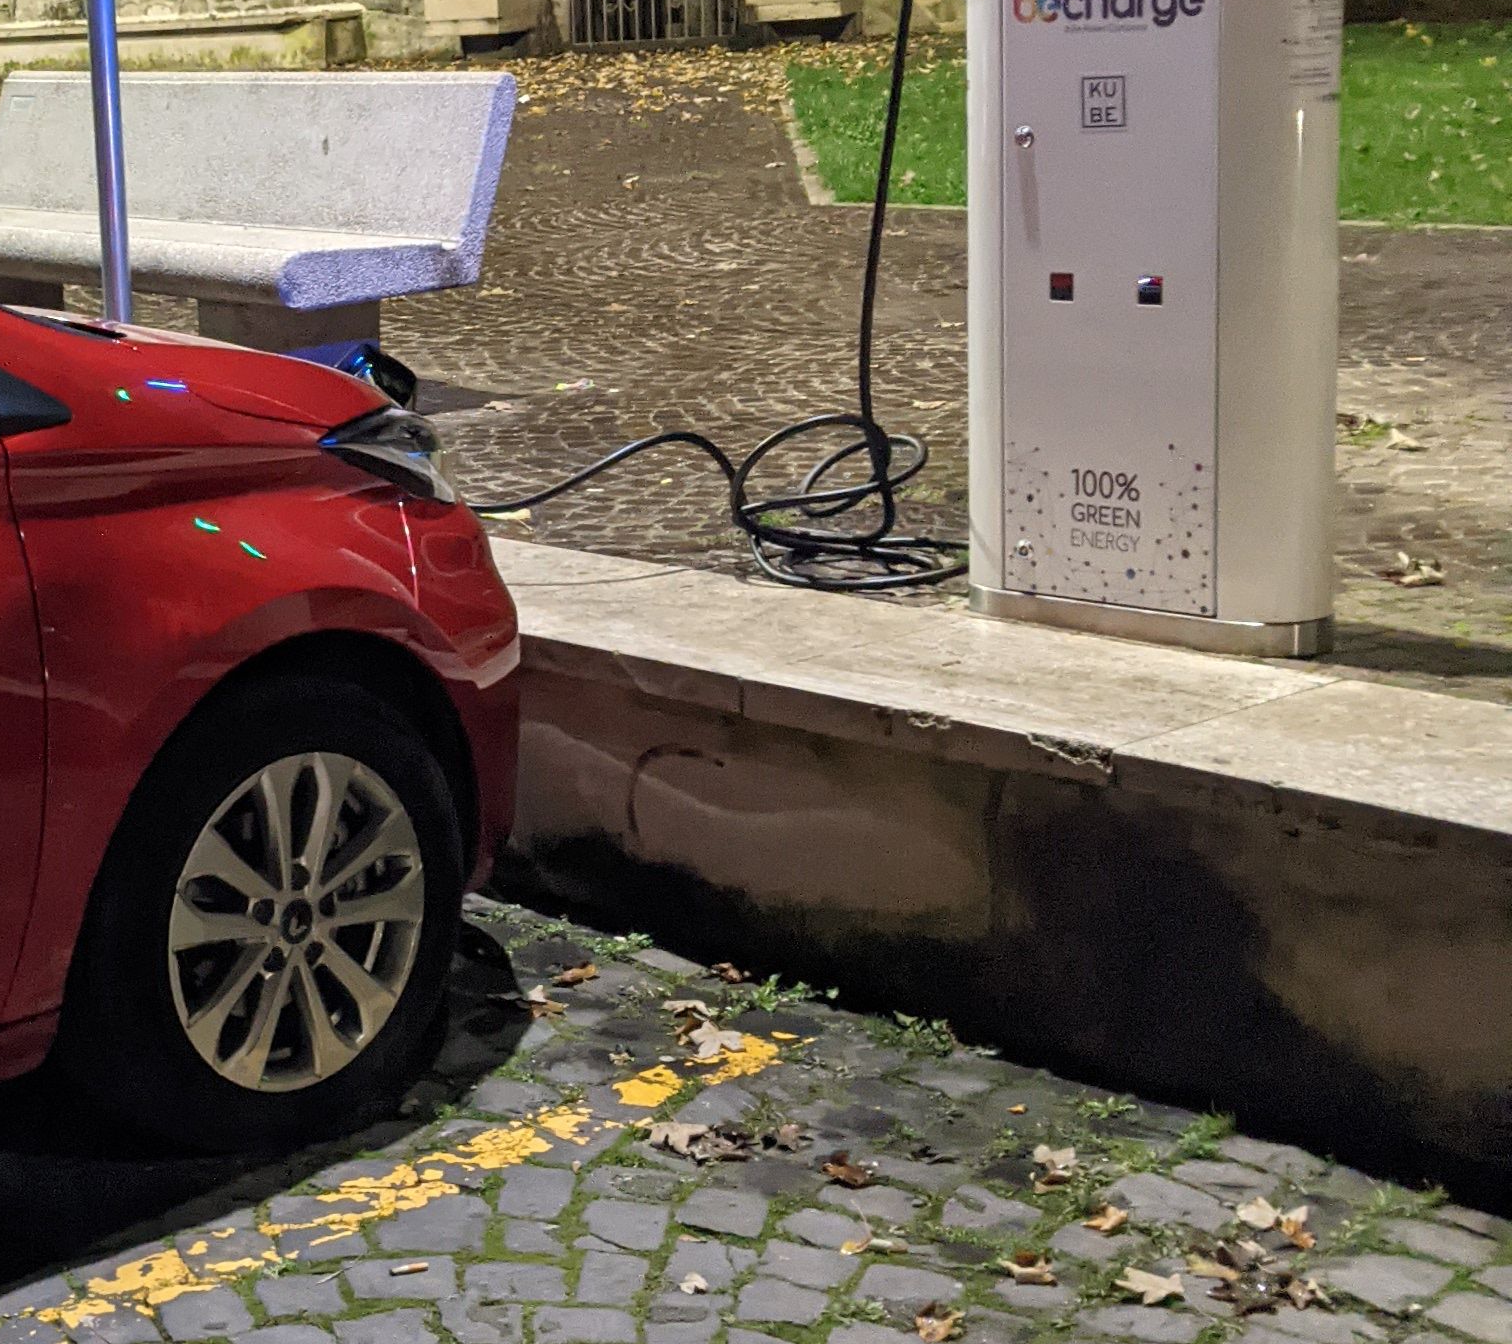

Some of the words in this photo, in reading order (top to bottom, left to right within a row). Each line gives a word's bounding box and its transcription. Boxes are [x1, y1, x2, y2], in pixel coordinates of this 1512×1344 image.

[1089, 81, 1116, 97] KU
[1090, 107, 1117, 123] BE
[1071, 468, 1140, 502] 100%
[1071, 502, 1141, 529] GREEN
[1071, 528, 1141, 553] ENERGY
